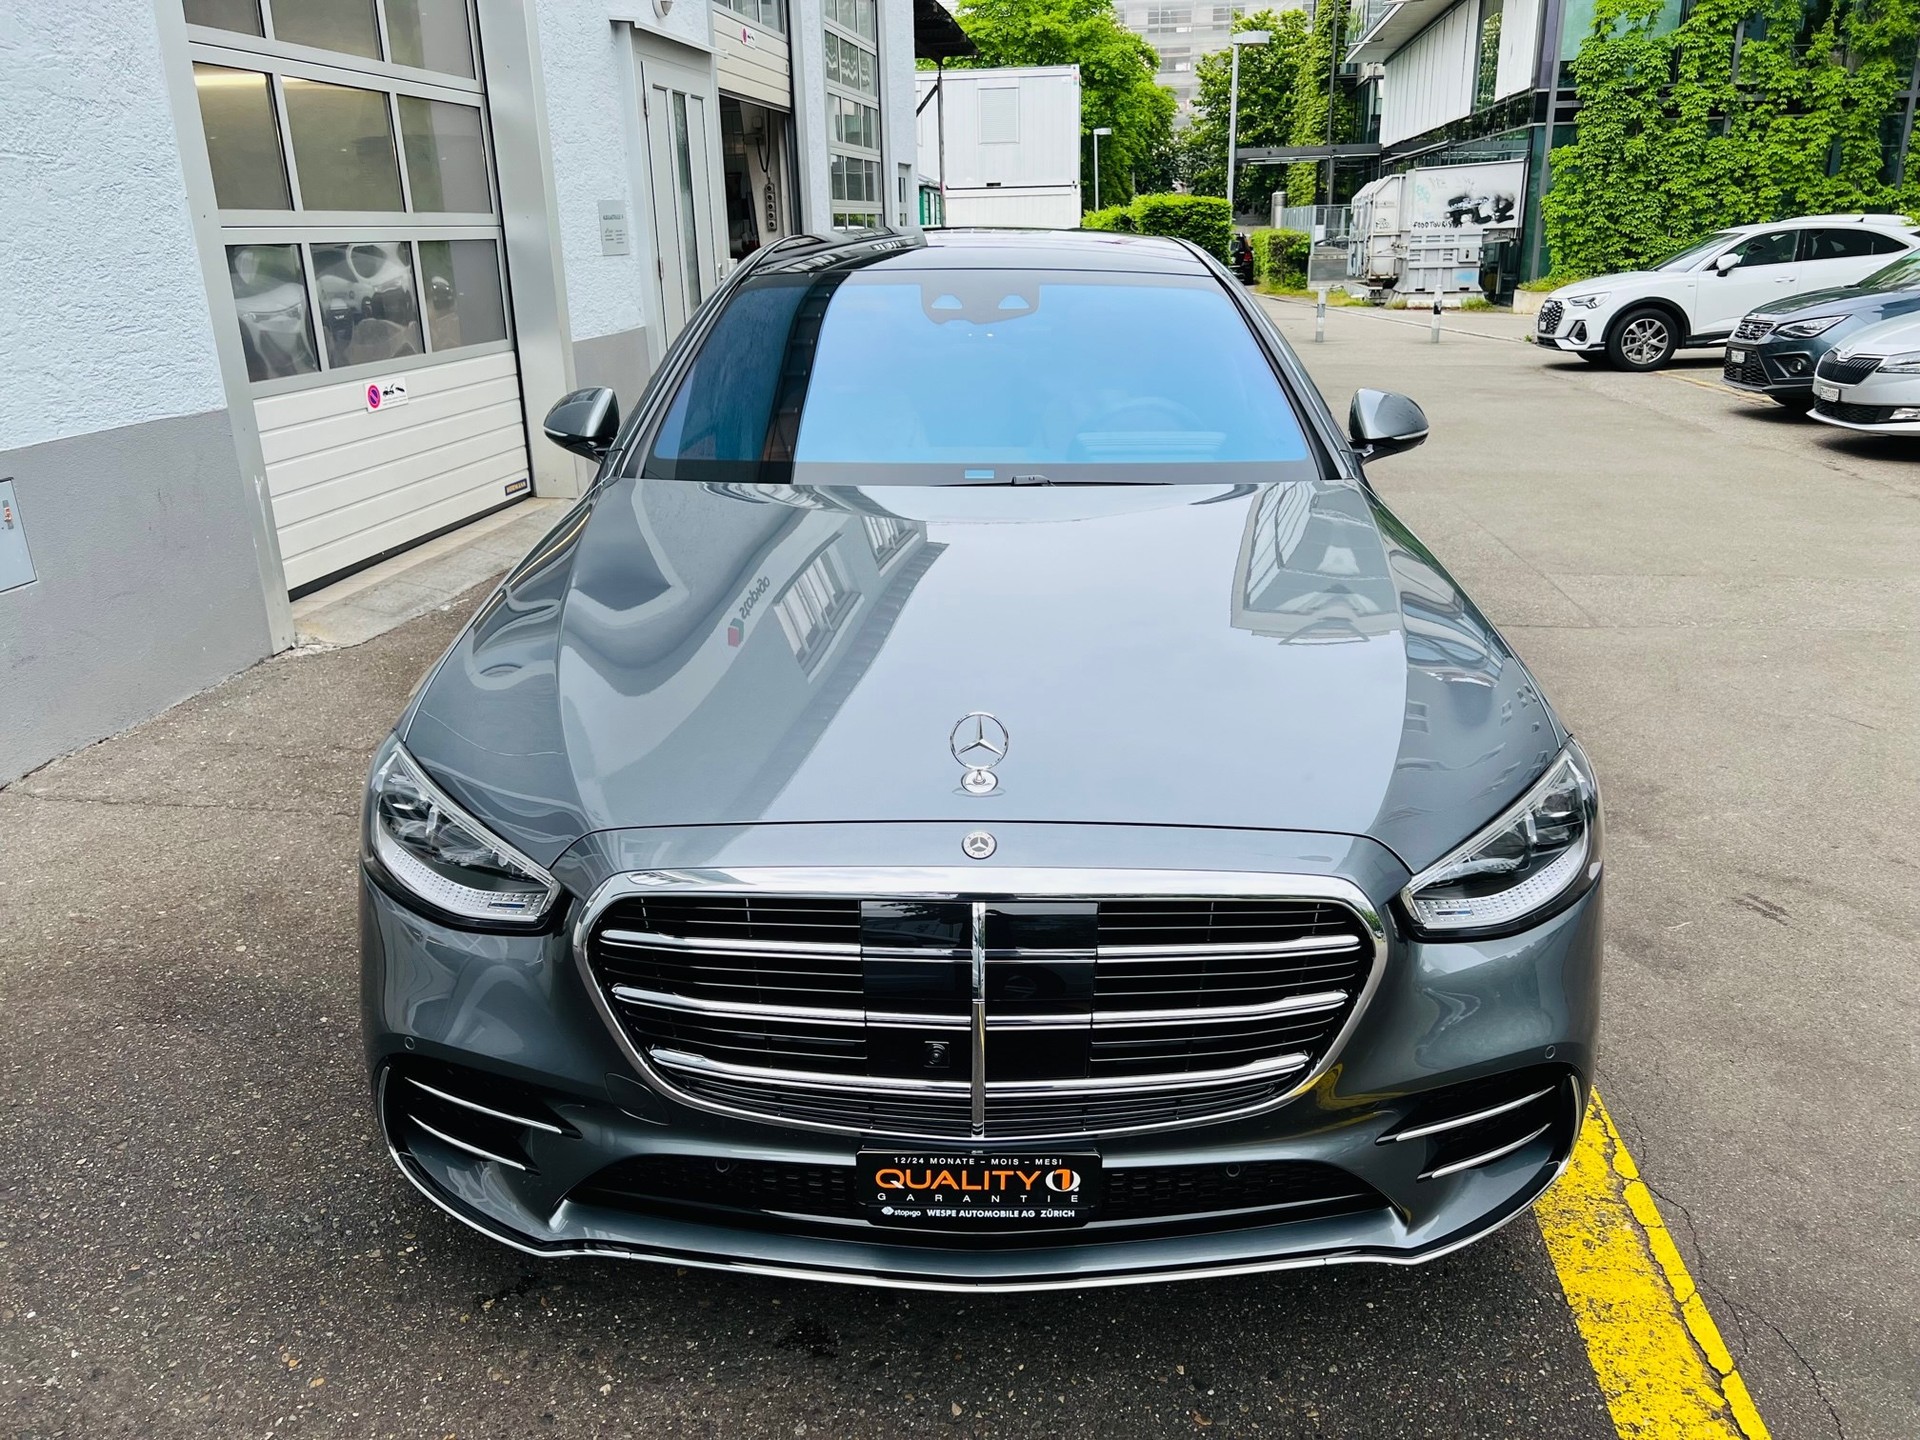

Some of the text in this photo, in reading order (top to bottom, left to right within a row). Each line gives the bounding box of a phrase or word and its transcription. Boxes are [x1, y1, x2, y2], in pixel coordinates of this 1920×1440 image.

[930, 1157, 975, 1165] MONATE
[991, 1158, 1019, 1166] MOIS
[1035, 1158, 1062, 1166] MESI
[875, 1168, 1041, 1191] QUALITY
[877, 1192, 1079, 1203] GARANTIE
[926, 1209, 957, 1217] WESPE
[959, 1210, 1019, 1218] AUTOMOBILE
[1021, 1210, 1036, 1218] AG
[1040, 1208, 1075, 1218] ZÜRICH
